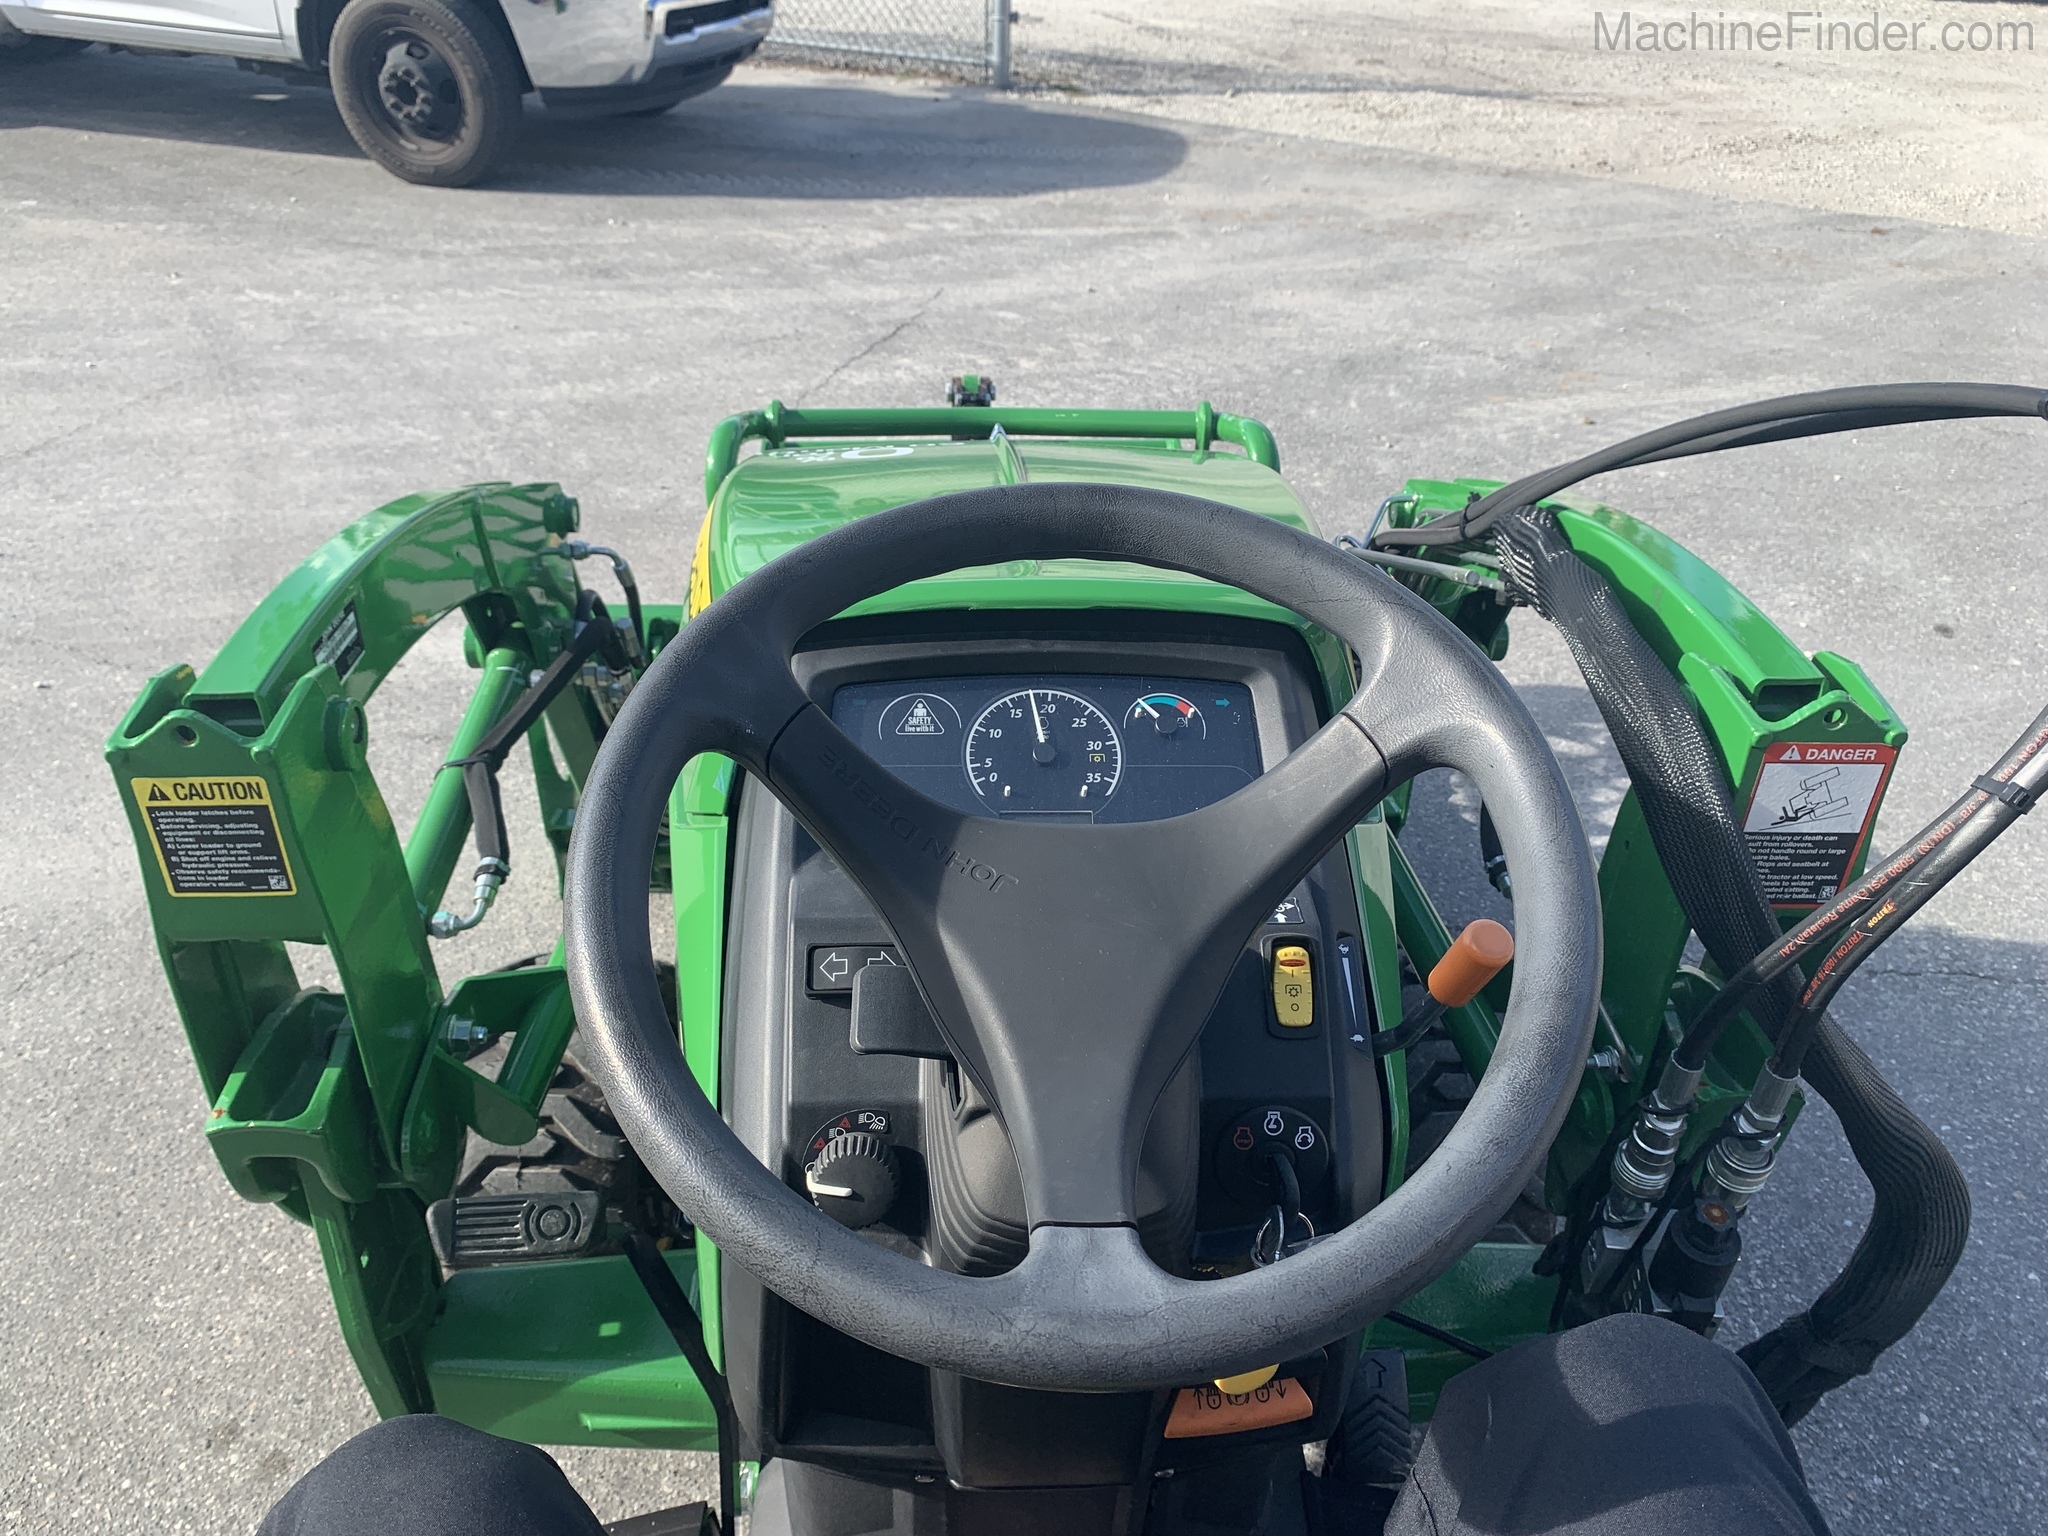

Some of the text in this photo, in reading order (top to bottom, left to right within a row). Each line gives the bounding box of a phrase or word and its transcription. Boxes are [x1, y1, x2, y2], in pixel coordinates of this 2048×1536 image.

[1009, 708, 1023, 719] 15
[1040, 704, 1056, 714] 20
[907, 716, 932, 725] SAFETY
[1071, 718, 1088, 728] 25
[904, 724, 916, 732] live
[916, 724, 928, 732] with
[988, 728, 1002, 739] 10
[1086, 741, 1103, 751] 30
[1805, 749, 1877, 761] DANGER
[984, 757, 993, 768] 5
[989, 772, 998, 783] 0
[1085, 773, 1102, 783] 35
[172, 782, 264, 801] CAUTION
[818, 745, 1019, 892] JOHN DEERE
[1771, 834, 1793, 842] injury
[235, 842, 262, 850] ground
[1887, 854, 1916, 878] 5000
[1868, 874, 1889, 892] PSI
[1866, 901, 1895, 929] TRITON
[1835, 930, 1866, 959] TRITON
